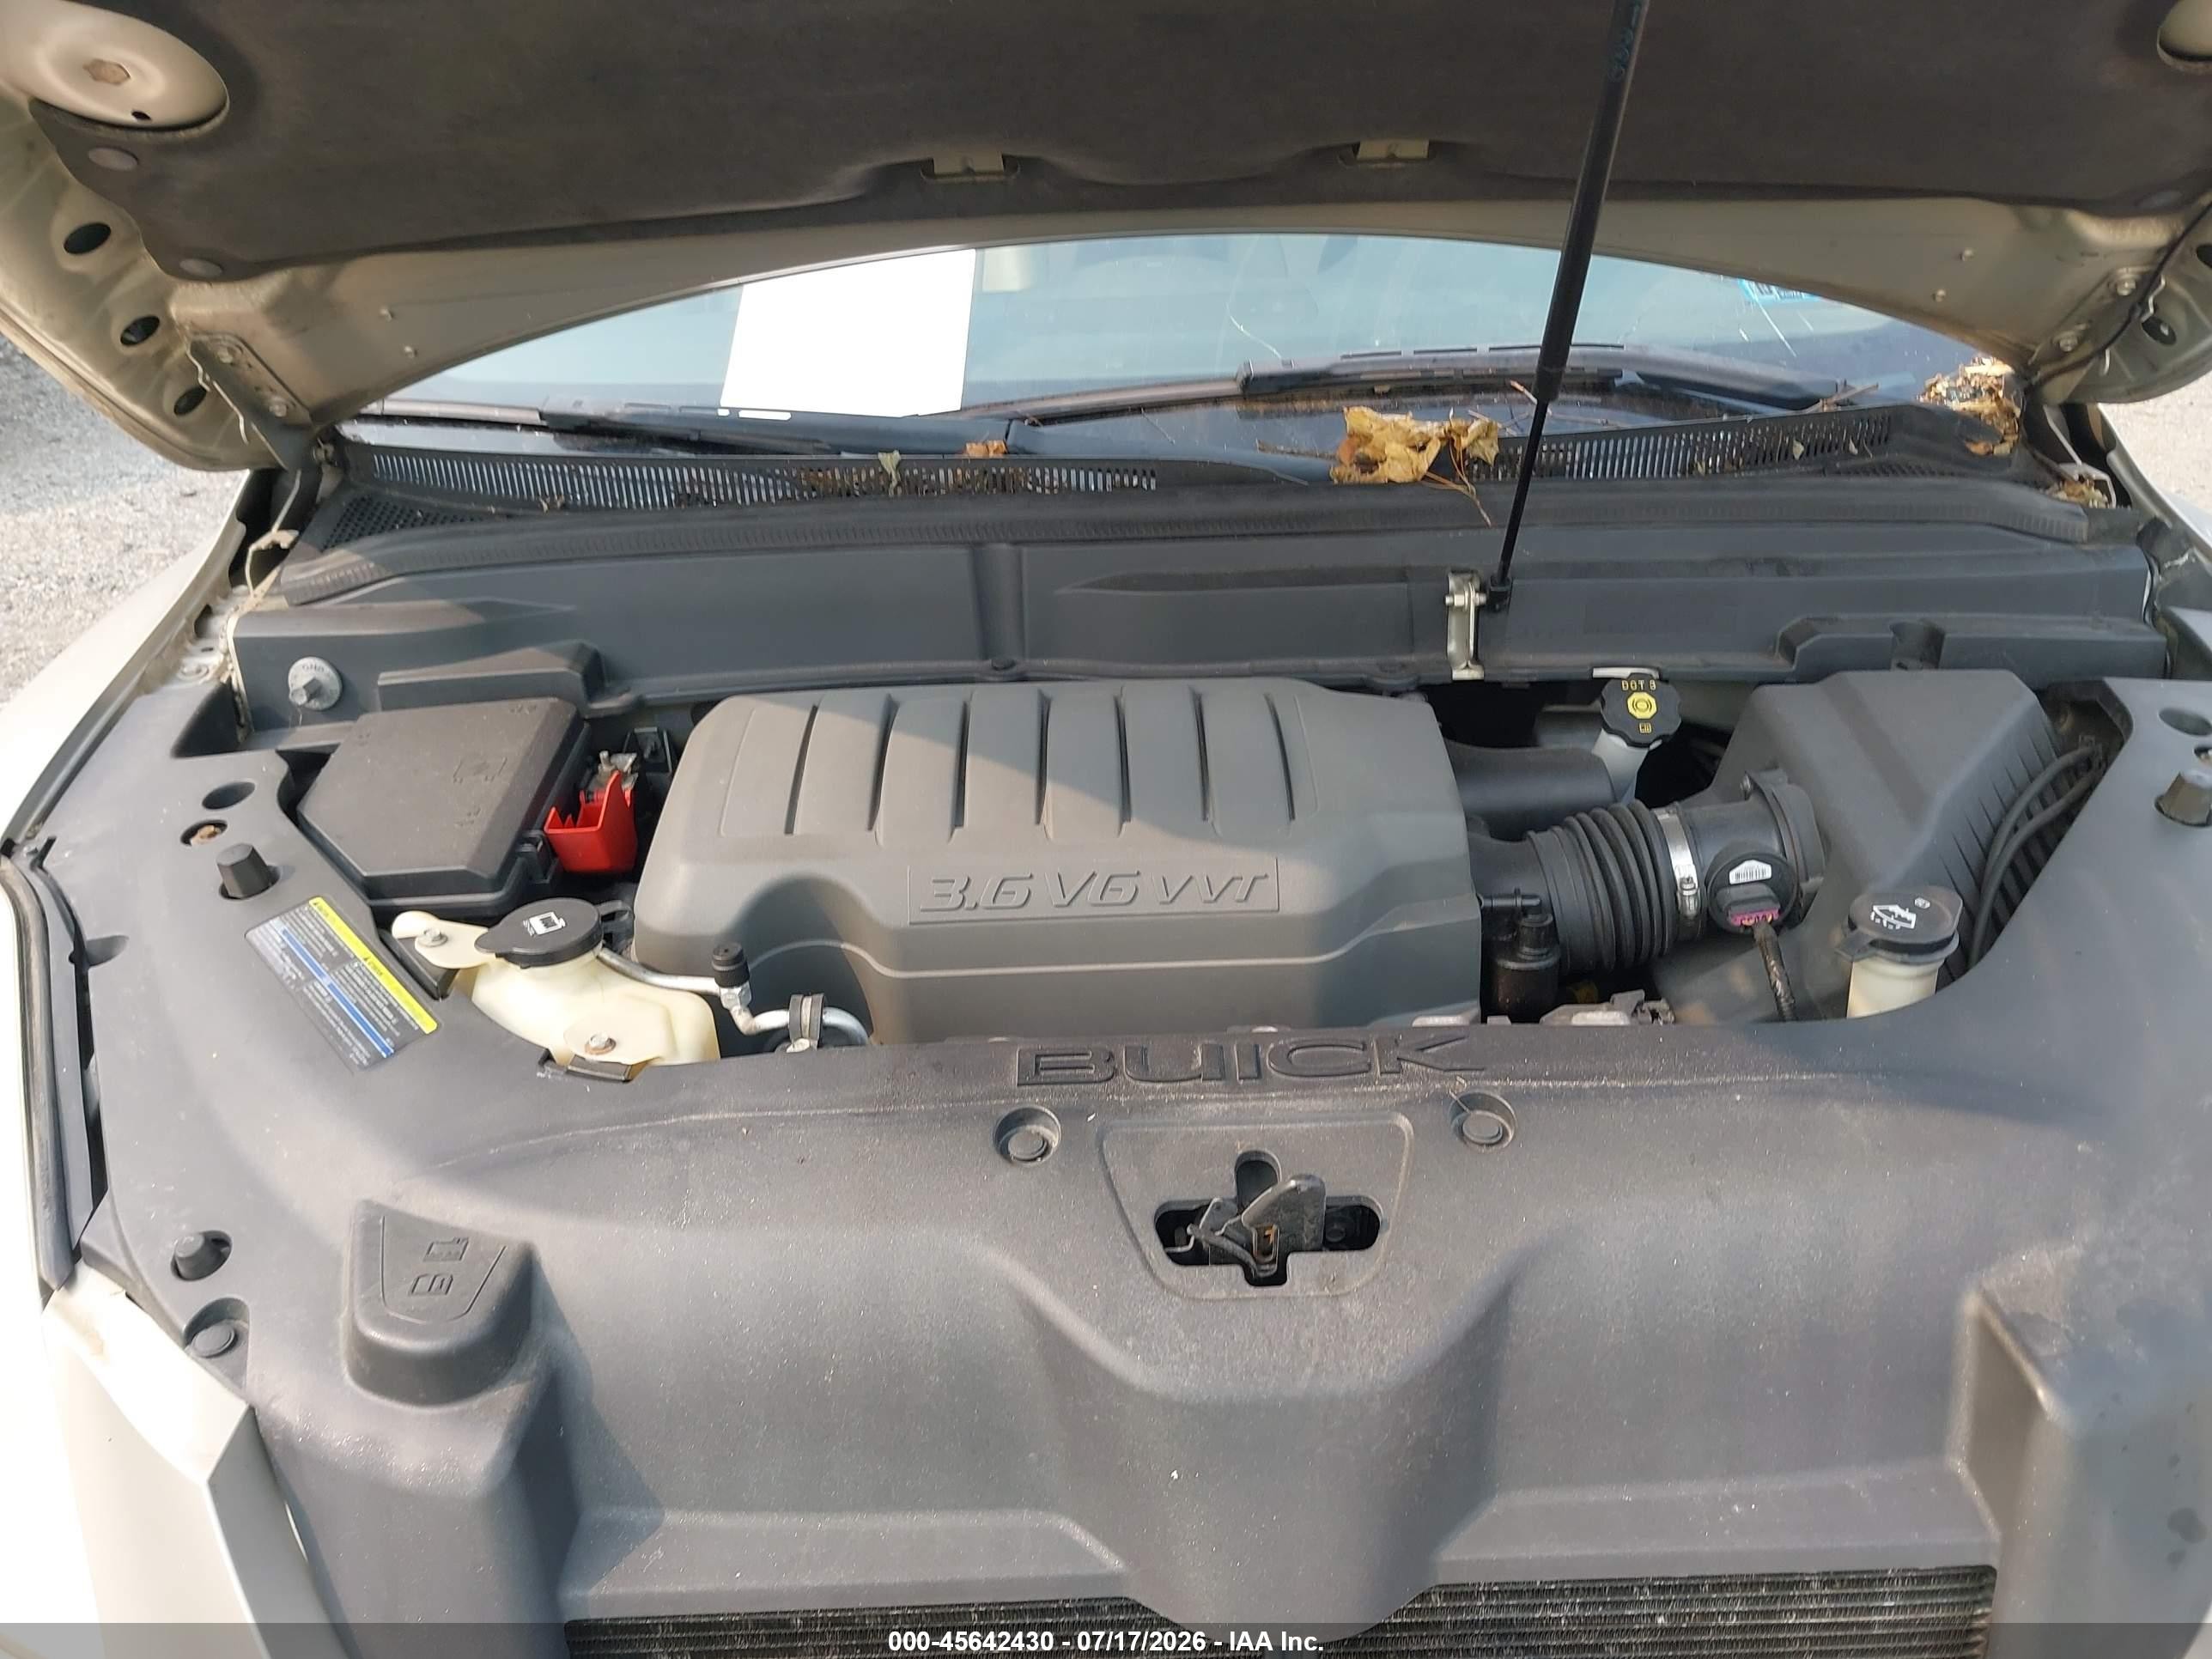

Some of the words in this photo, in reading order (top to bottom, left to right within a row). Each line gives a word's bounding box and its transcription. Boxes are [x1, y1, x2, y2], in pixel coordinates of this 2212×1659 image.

[1622, 680, 1644, 690] DOT
[920, 872, 1033, 912] 3.6
[1045, 870, 1141, 908] V6
[1152, 872, 1268, 906] VVT
[1016, 1033, 1486, 1087] BUICK
